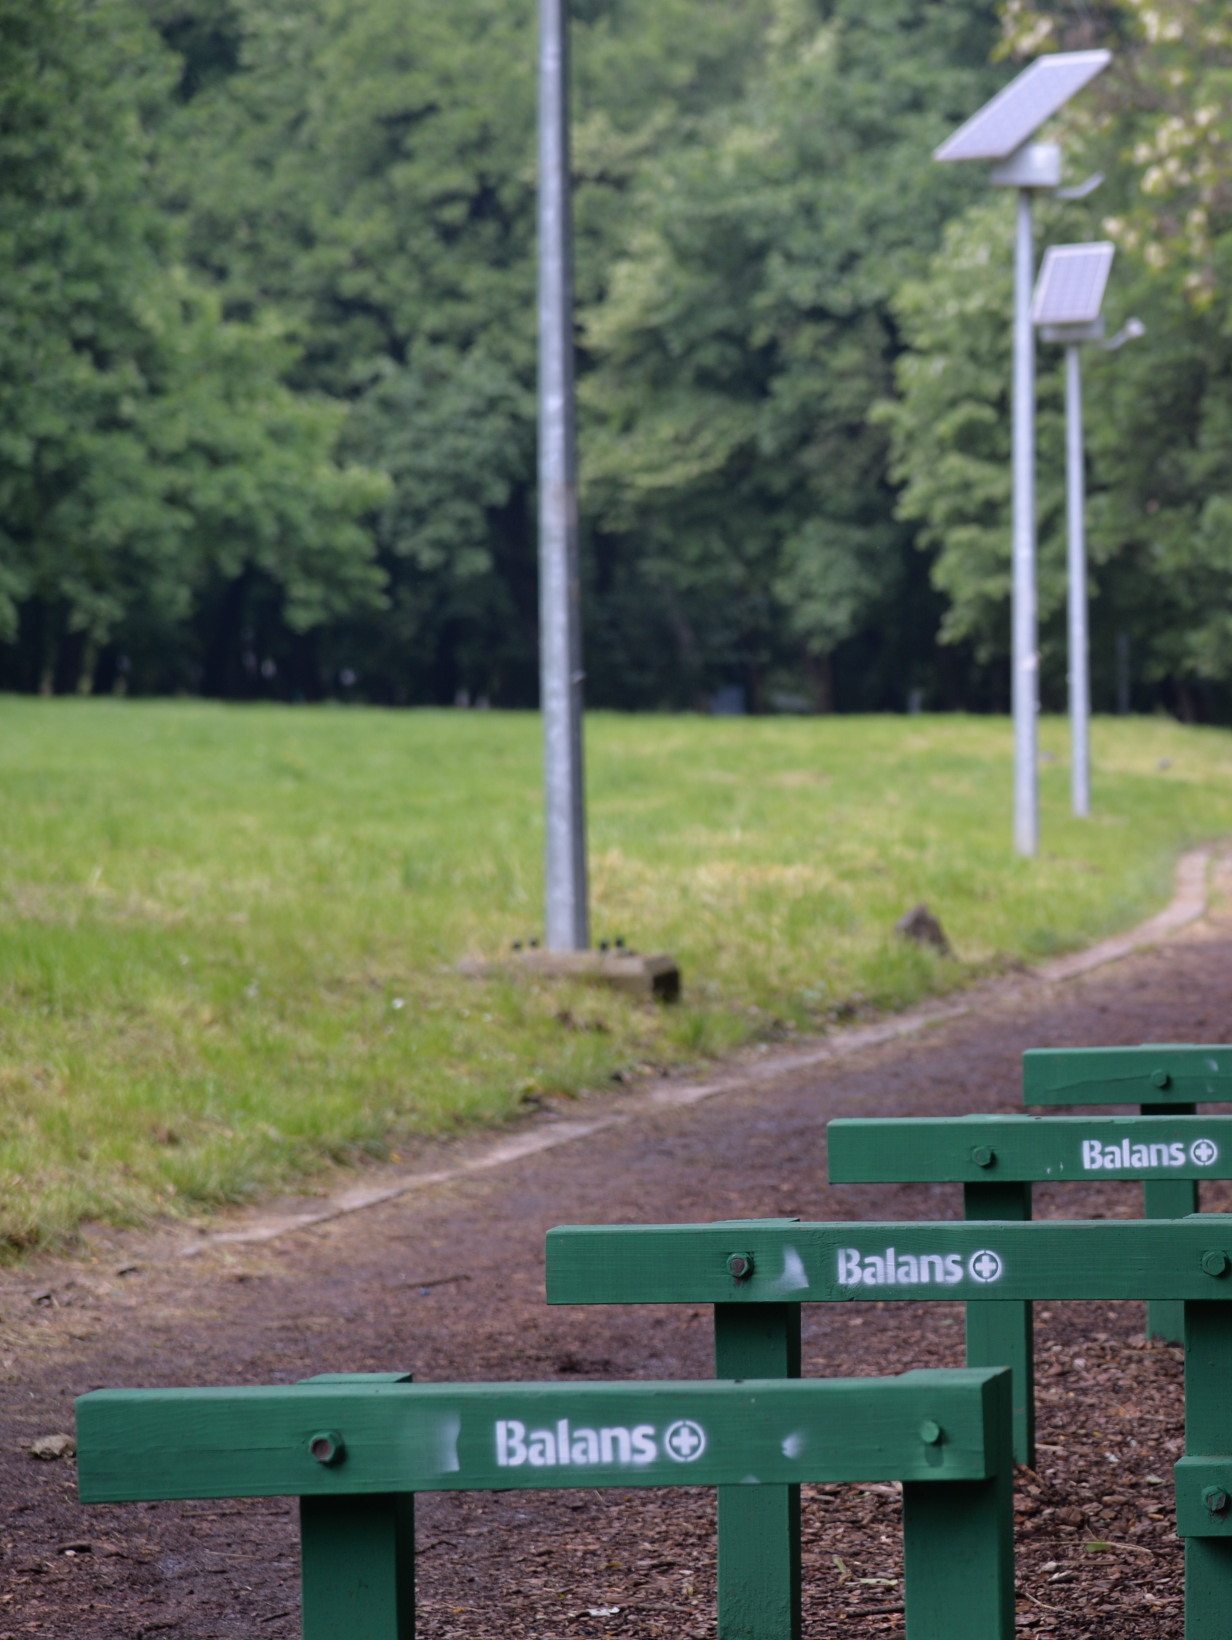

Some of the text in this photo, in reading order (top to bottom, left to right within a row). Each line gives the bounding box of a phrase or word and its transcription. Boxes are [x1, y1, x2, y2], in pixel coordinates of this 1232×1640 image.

[1082, 1138, 1186, 1170] Balans
[838, 1247, 964, 1285] Balans
[495, 1418, 658, 1466] Balans
